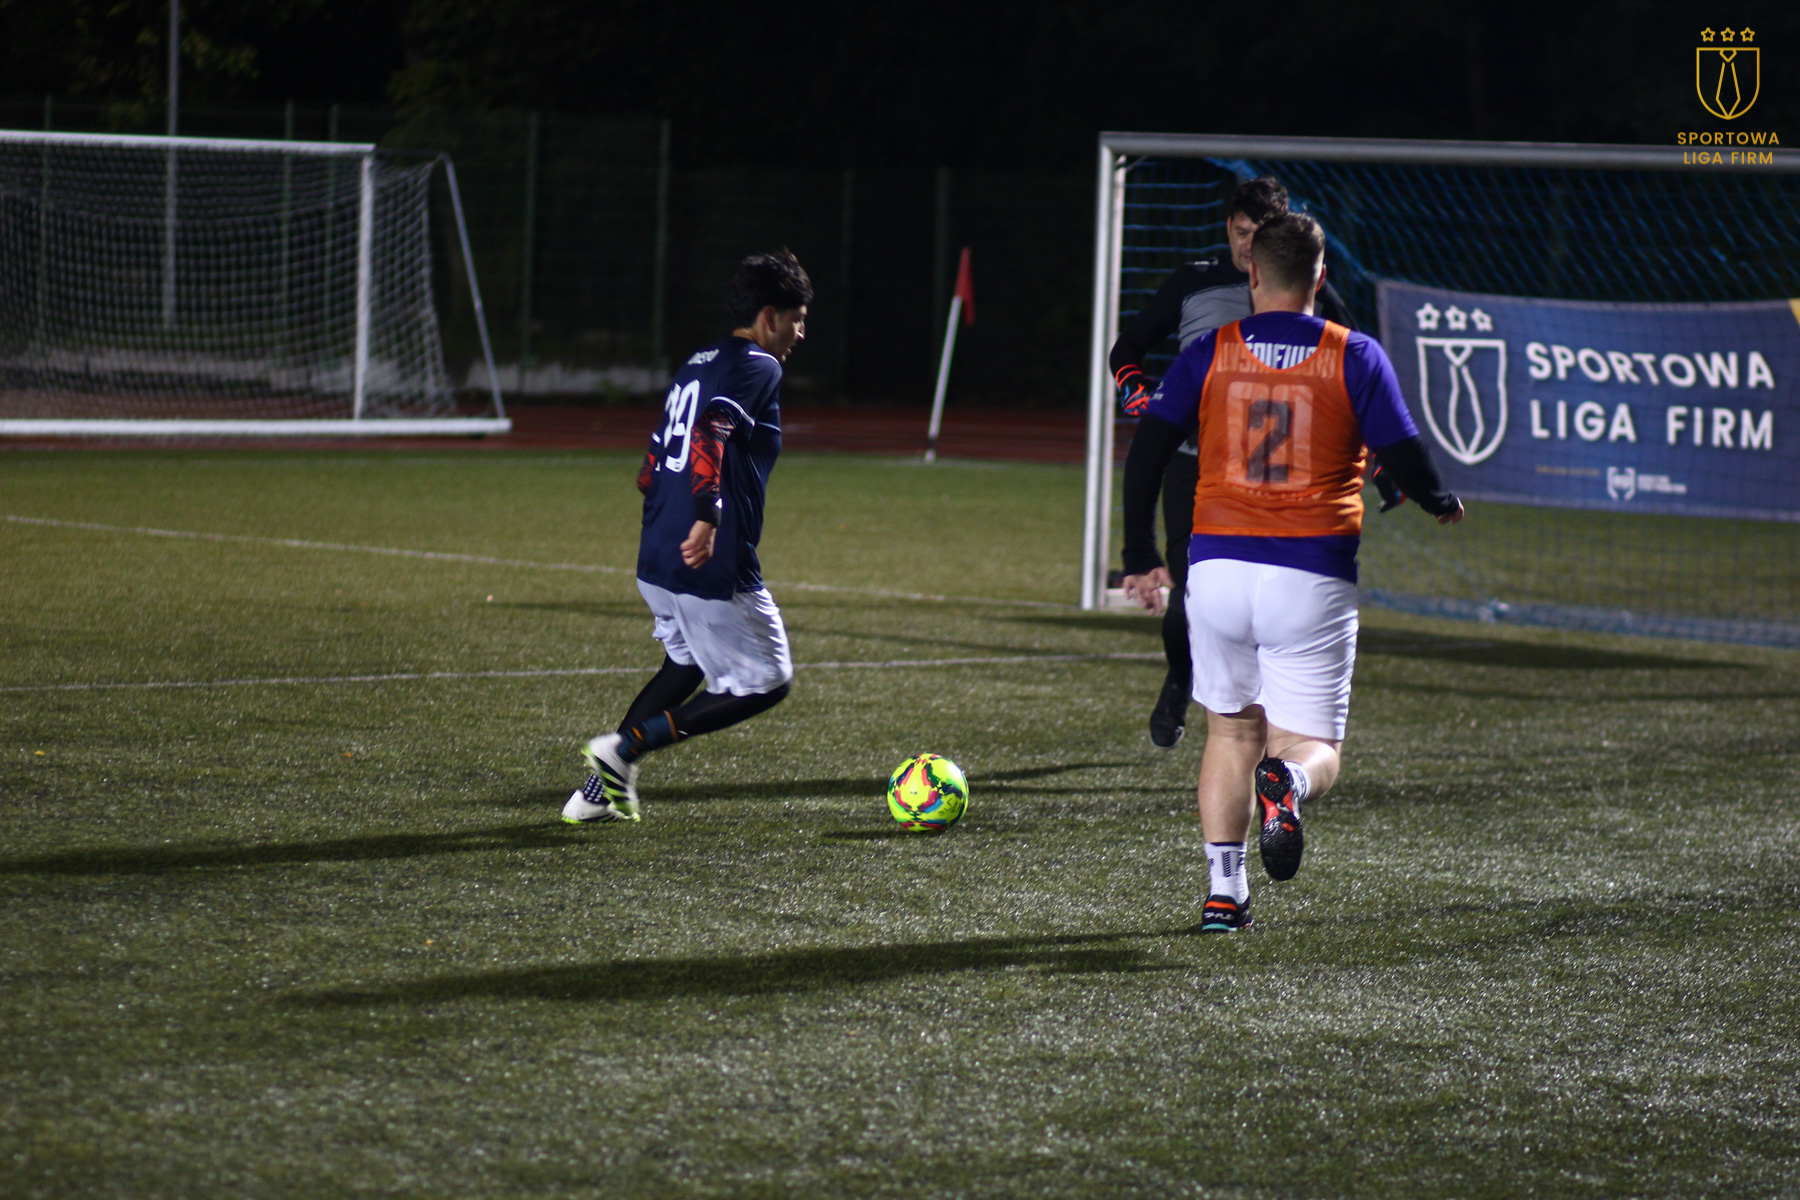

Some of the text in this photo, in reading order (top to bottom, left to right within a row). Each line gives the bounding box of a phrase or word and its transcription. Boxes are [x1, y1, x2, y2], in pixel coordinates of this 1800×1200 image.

[1526, 341, 1775, 389] SPORTOWA
[1530, 400, 1773, 450] LIGA FIRM
